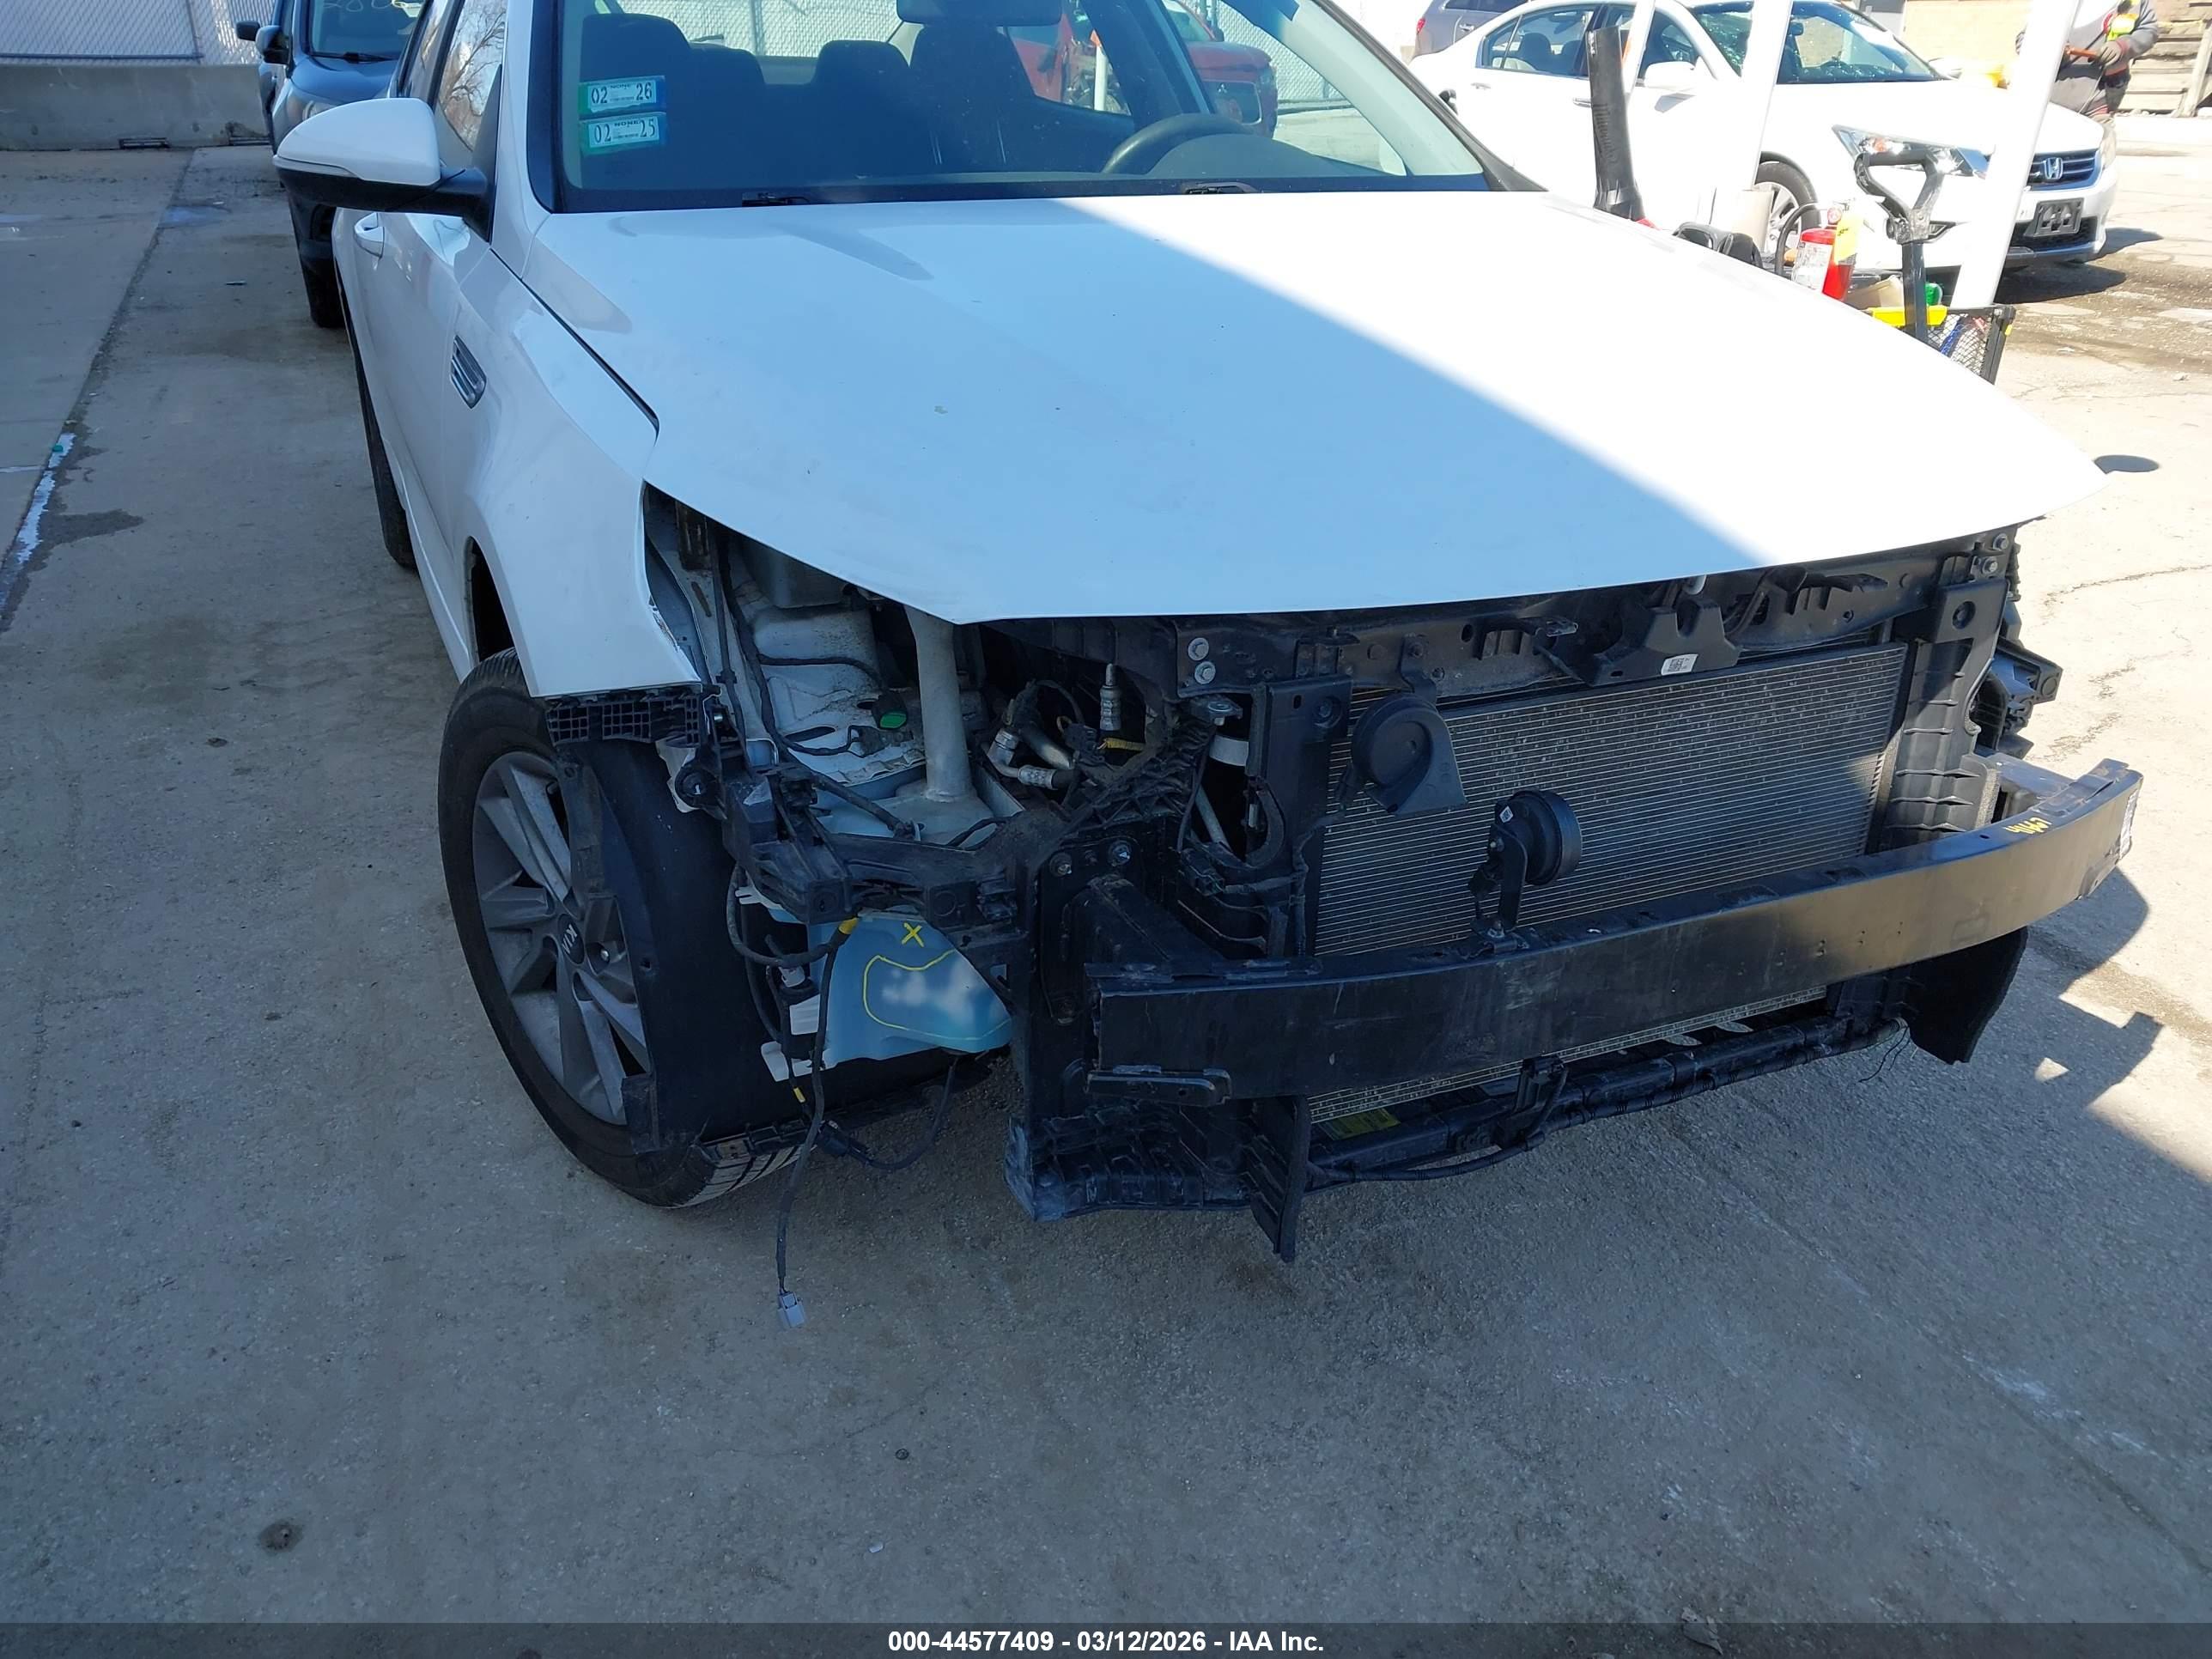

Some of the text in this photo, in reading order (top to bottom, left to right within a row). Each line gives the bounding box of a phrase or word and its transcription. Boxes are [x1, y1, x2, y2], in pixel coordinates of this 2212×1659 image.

[592, 87, 608, 104] 02
[636, 82, 653, 100] 26
[594, 123, 611, 143] 02
[640, 118, 655, 137] 25
[562, 924, 578, 955] KIA
